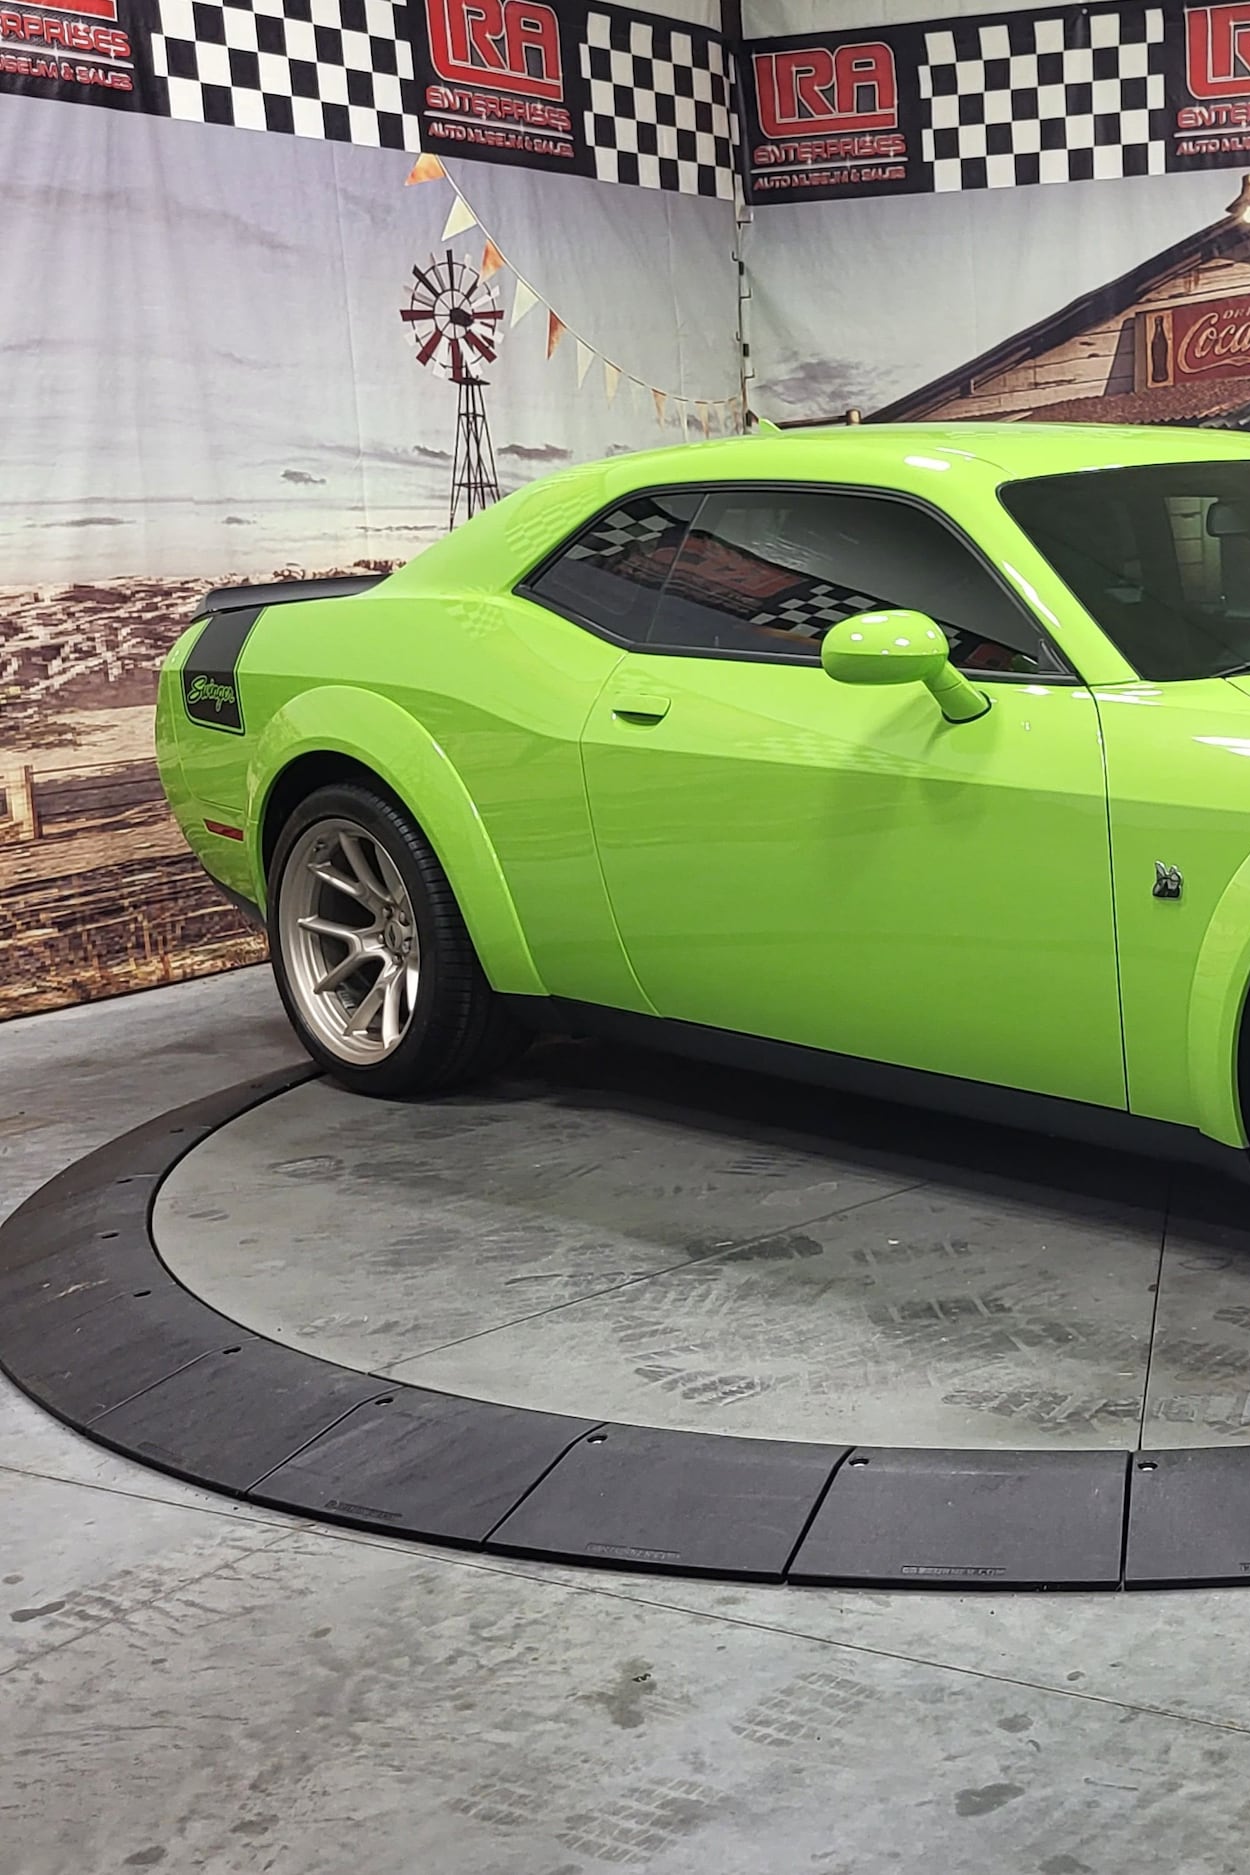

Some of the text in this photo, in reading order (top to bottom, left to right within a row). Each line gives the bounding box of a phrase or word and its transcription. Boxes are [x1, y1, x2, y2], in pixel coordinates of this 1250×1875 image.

[0, 10, 131, 57] RPRISES
[60, 62, 74, 81] &
[75, 66, 133, 92] SALES
[425, 85, 572, 131] ENTERPRISES
[428, 122, 467, 140] AUTO
[754, 134, 906, 165] ENTERPRISES
[1175, 138, 1221, 156] AUTO
[754, 175, 791, 191] AUTO
[186, 674, 236, 713] Swinger
